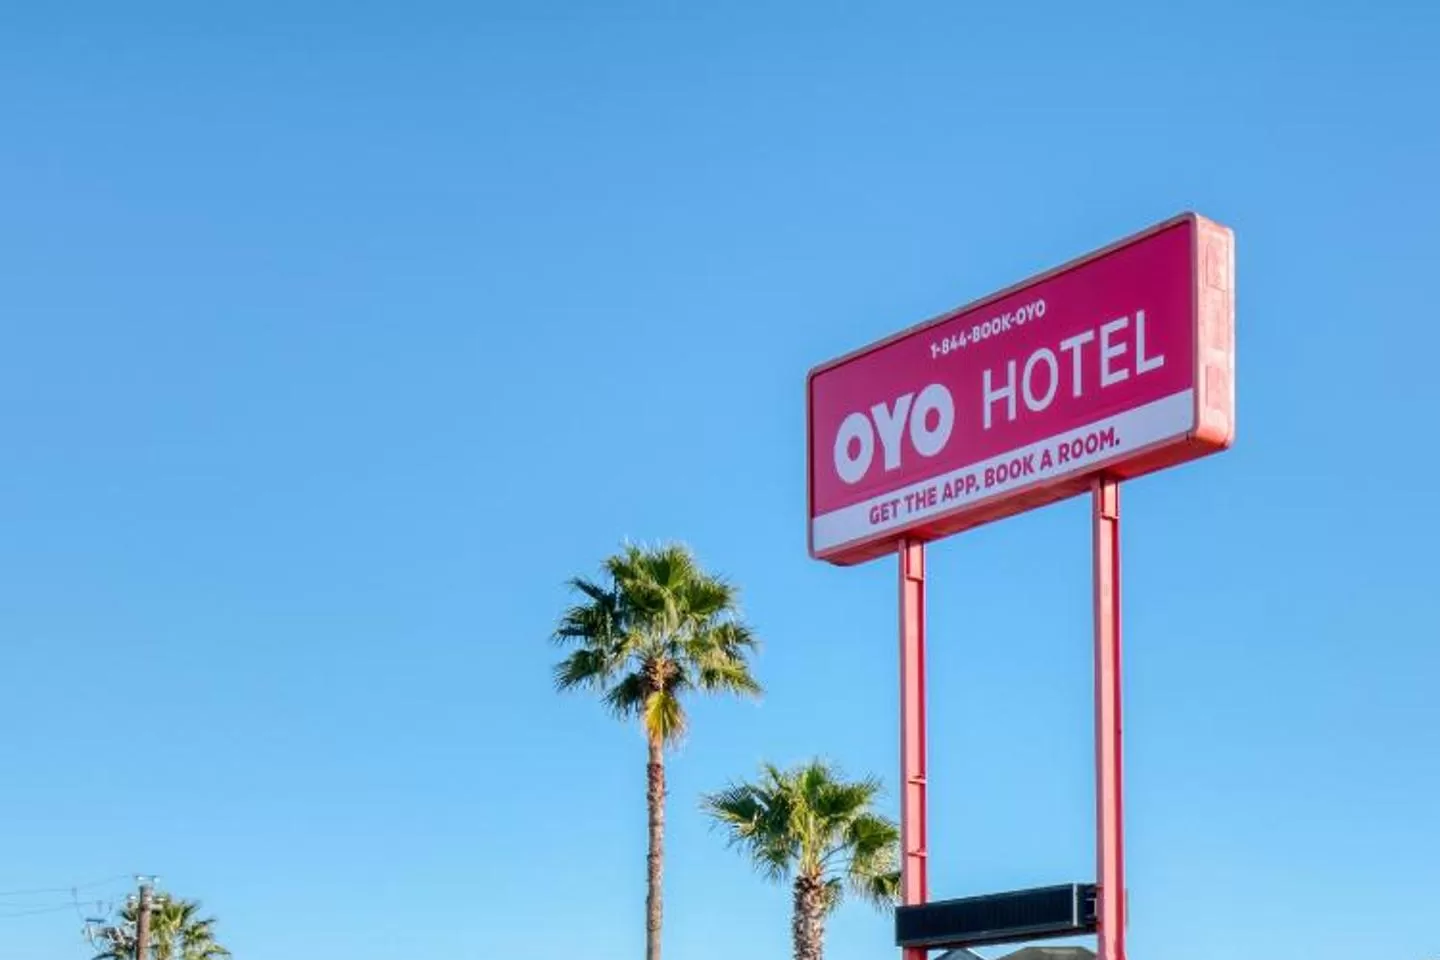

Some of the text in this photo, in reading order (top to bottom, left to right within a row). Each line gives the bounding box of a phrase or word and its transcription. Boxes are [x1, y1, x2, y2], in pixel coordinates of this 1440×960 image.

[930, 298, 1046, 359] 1-844-BOOK-OYO
[833, 309, 1165, 484] OYO HOTEL
[869, 427, 1120, 525] GET THE APP. BOOK A ROOM.
